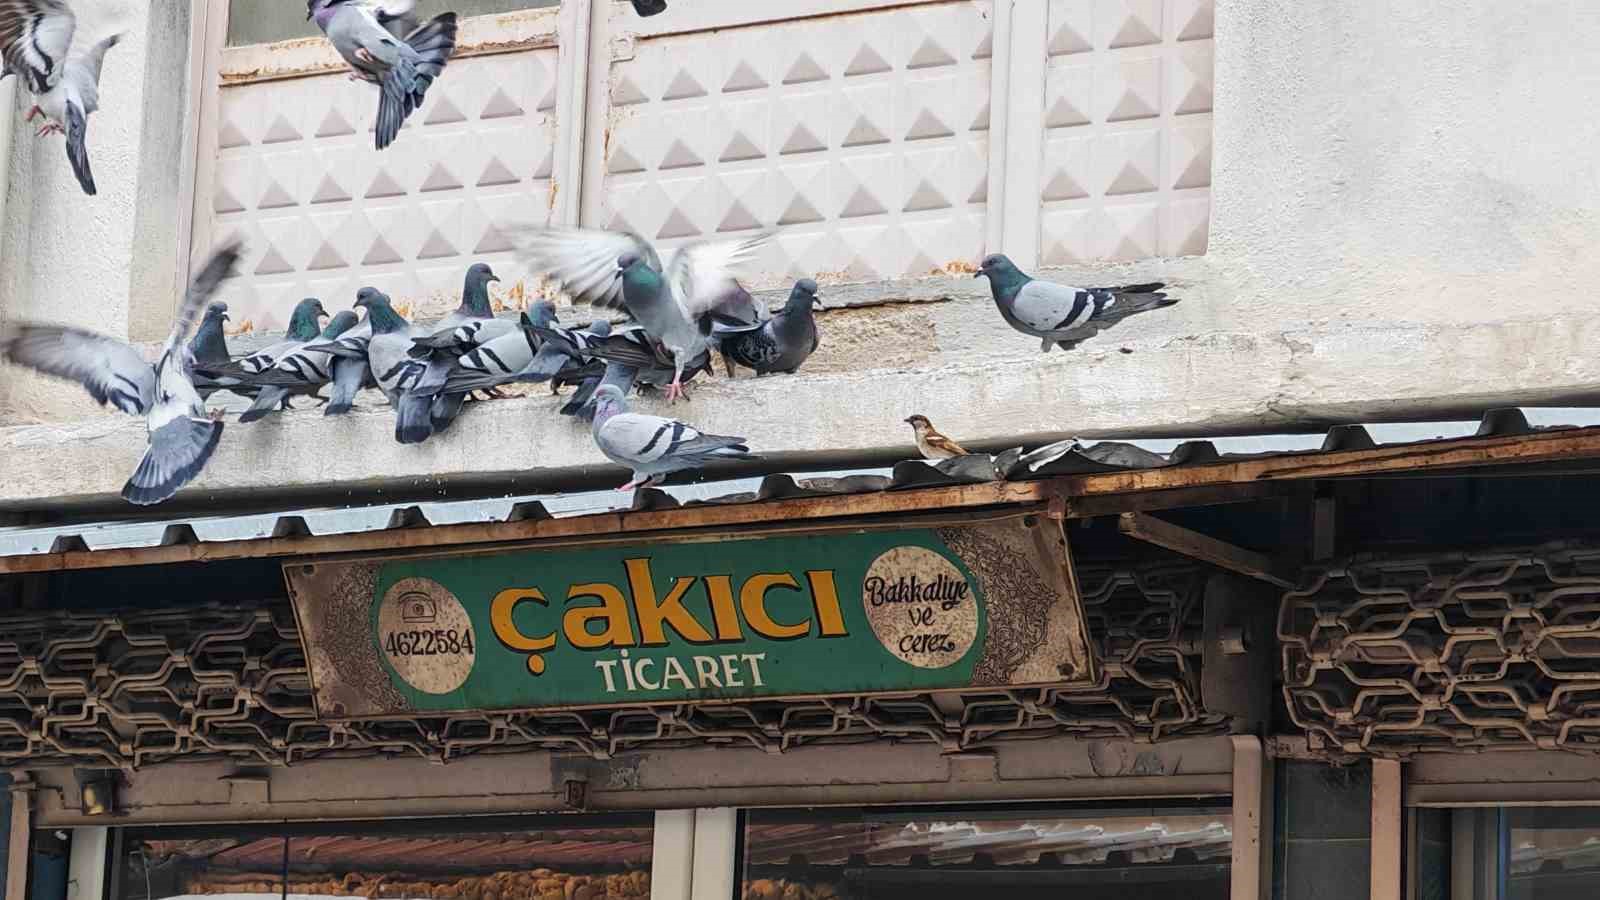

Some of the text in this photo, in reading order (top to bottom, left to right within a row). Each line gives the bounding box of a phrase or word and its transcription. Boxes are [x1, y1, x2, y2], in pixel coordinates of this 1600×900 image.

[864, 573, 969, 612] Bakkaliye
[908, 606, 936, 628] ve
[384, 628, 475, 658] 4622584
[899, 632, 956, 661] çerez
[594, 648, 767, 693] TİCARET
